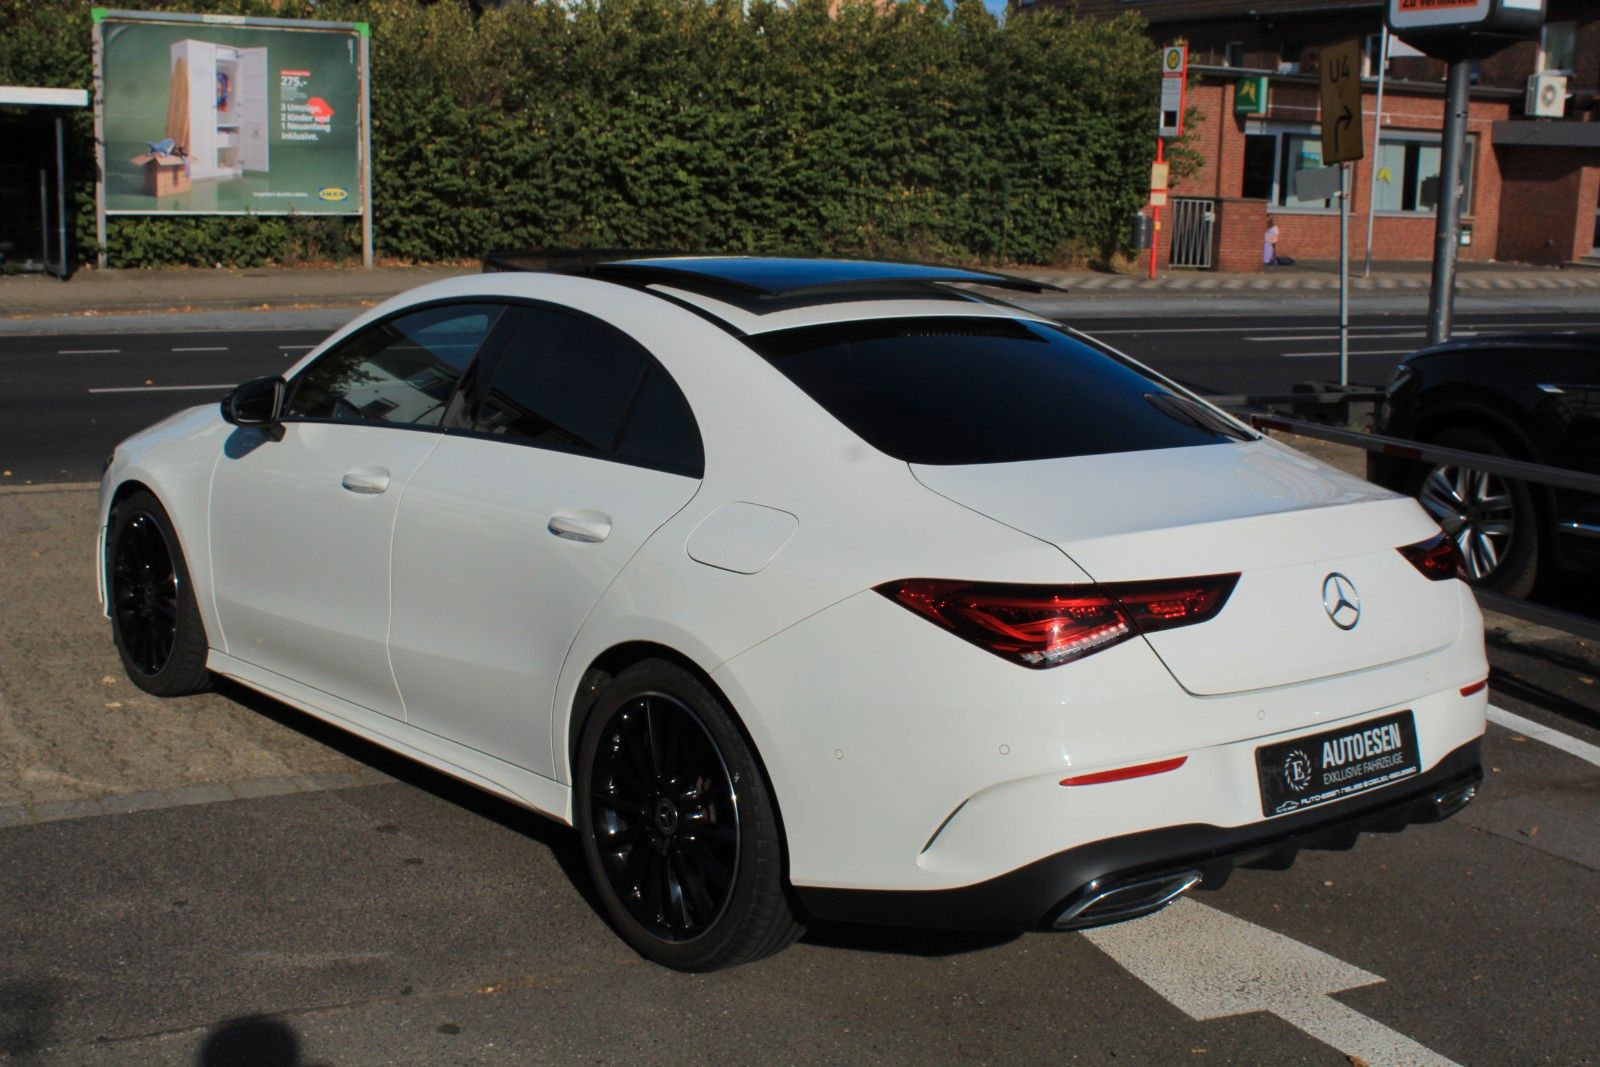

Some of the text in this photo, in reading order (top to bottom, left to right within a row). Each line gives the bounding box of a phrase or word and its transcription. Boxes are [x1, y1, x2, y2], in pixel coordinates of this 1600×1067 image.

[1329, 54, 1350, 83] U4
[1322, 723, 1402, 769] AUTOESEN
[1292, 760, 1306, 781] E
[1323, 763, 1363, 786] EXKLUSIVE
[1363, 752, 1404, 775] FAHRZEUGE
